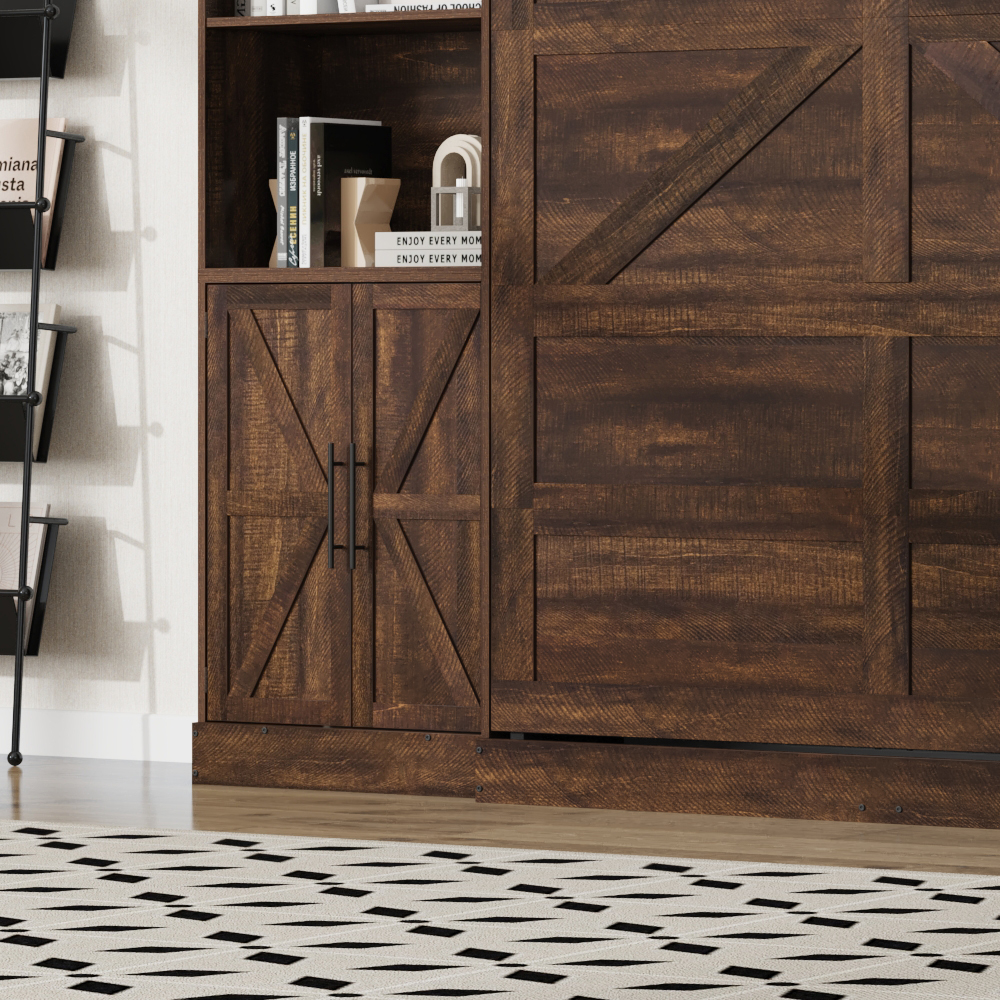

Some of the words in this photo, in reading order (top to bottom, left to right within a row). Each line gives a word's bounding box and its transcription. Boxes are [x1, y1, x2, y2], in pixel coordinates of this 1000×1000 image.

[289, 150, 297, 192] ИЗБРАННОЕ
[0, 178, 25, 191] sta
[302, 176, 307, 187] НА
[396, 236, 425, 246] ENJOY
[429, 236, 457, 246] EVERY
[461, 236, 482, 245] MOM
[396, 255, 425, 264] ENJOY
[429, 254, 457, 263] EVERY
[461, 254, 482, 263] MOM
